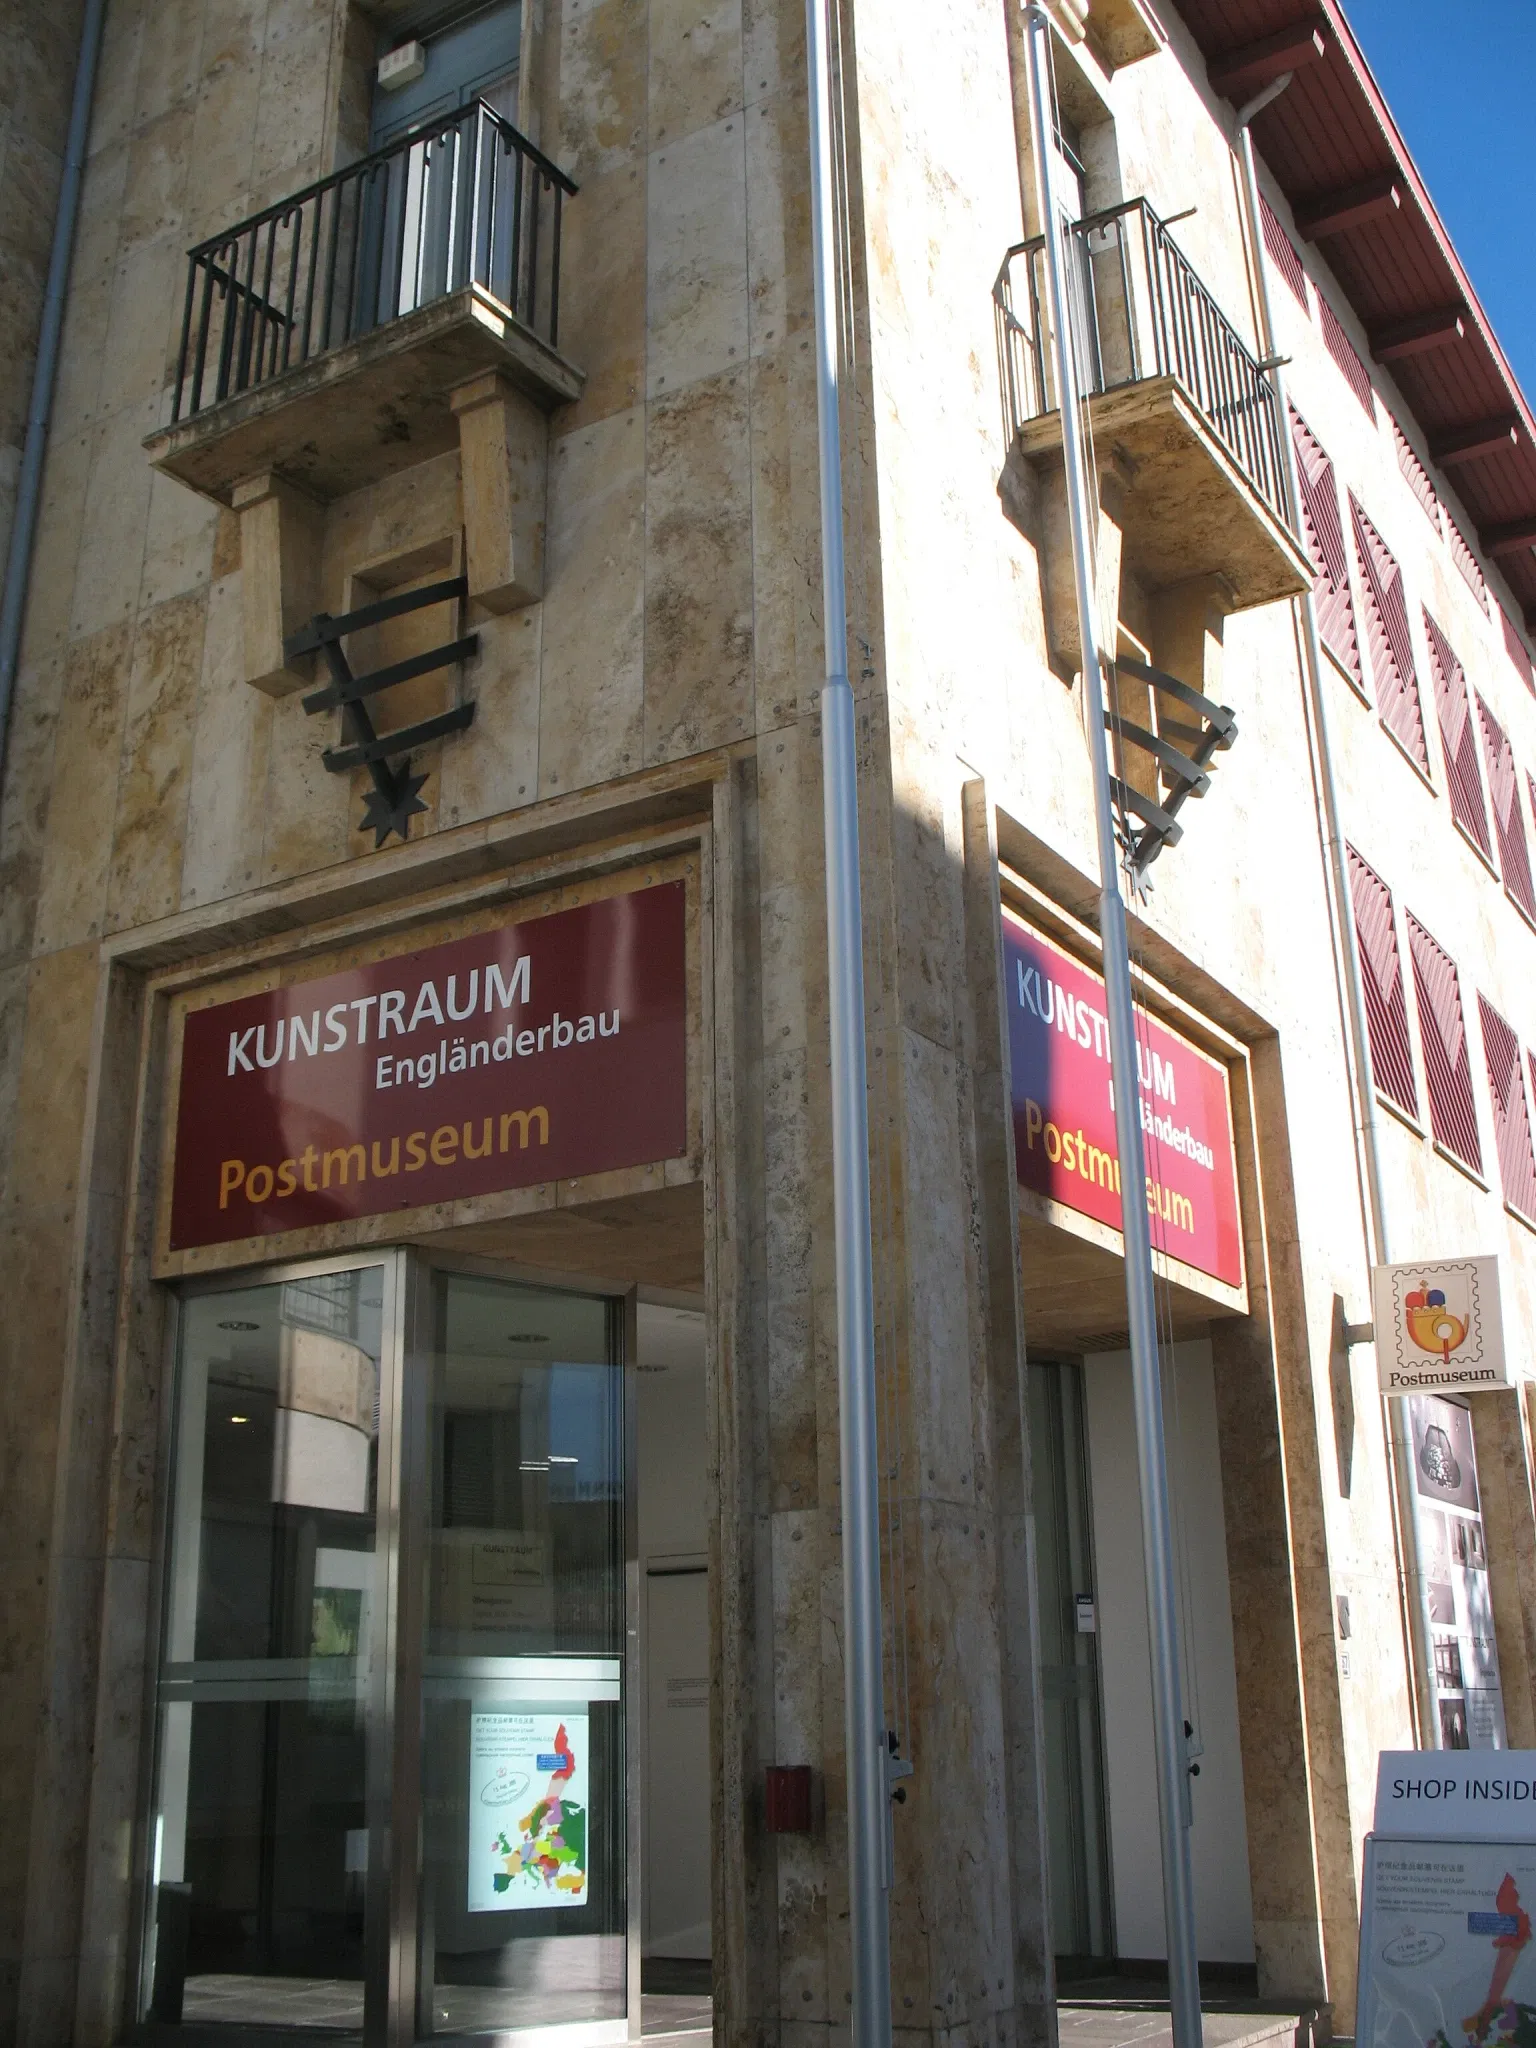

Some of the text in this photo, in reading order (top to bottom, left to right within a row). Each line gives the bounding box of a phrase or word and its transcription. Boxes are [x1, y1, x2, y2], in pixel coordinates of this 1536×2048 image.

[226, 954, 532, 1077] KUNSTRAUM
[375, 1008, 621, 1090] Engländerbau
[1016, 957, 1177, 1106] KUNSTUM
[218, 1105, 550, 1210] Postmuseum
[1024, 1097, 1195, 1235] Postmeum
[1389, 1368, 1497, 1387] Postmuseum
[1392, 1779, 1457, 1799] SHOP
